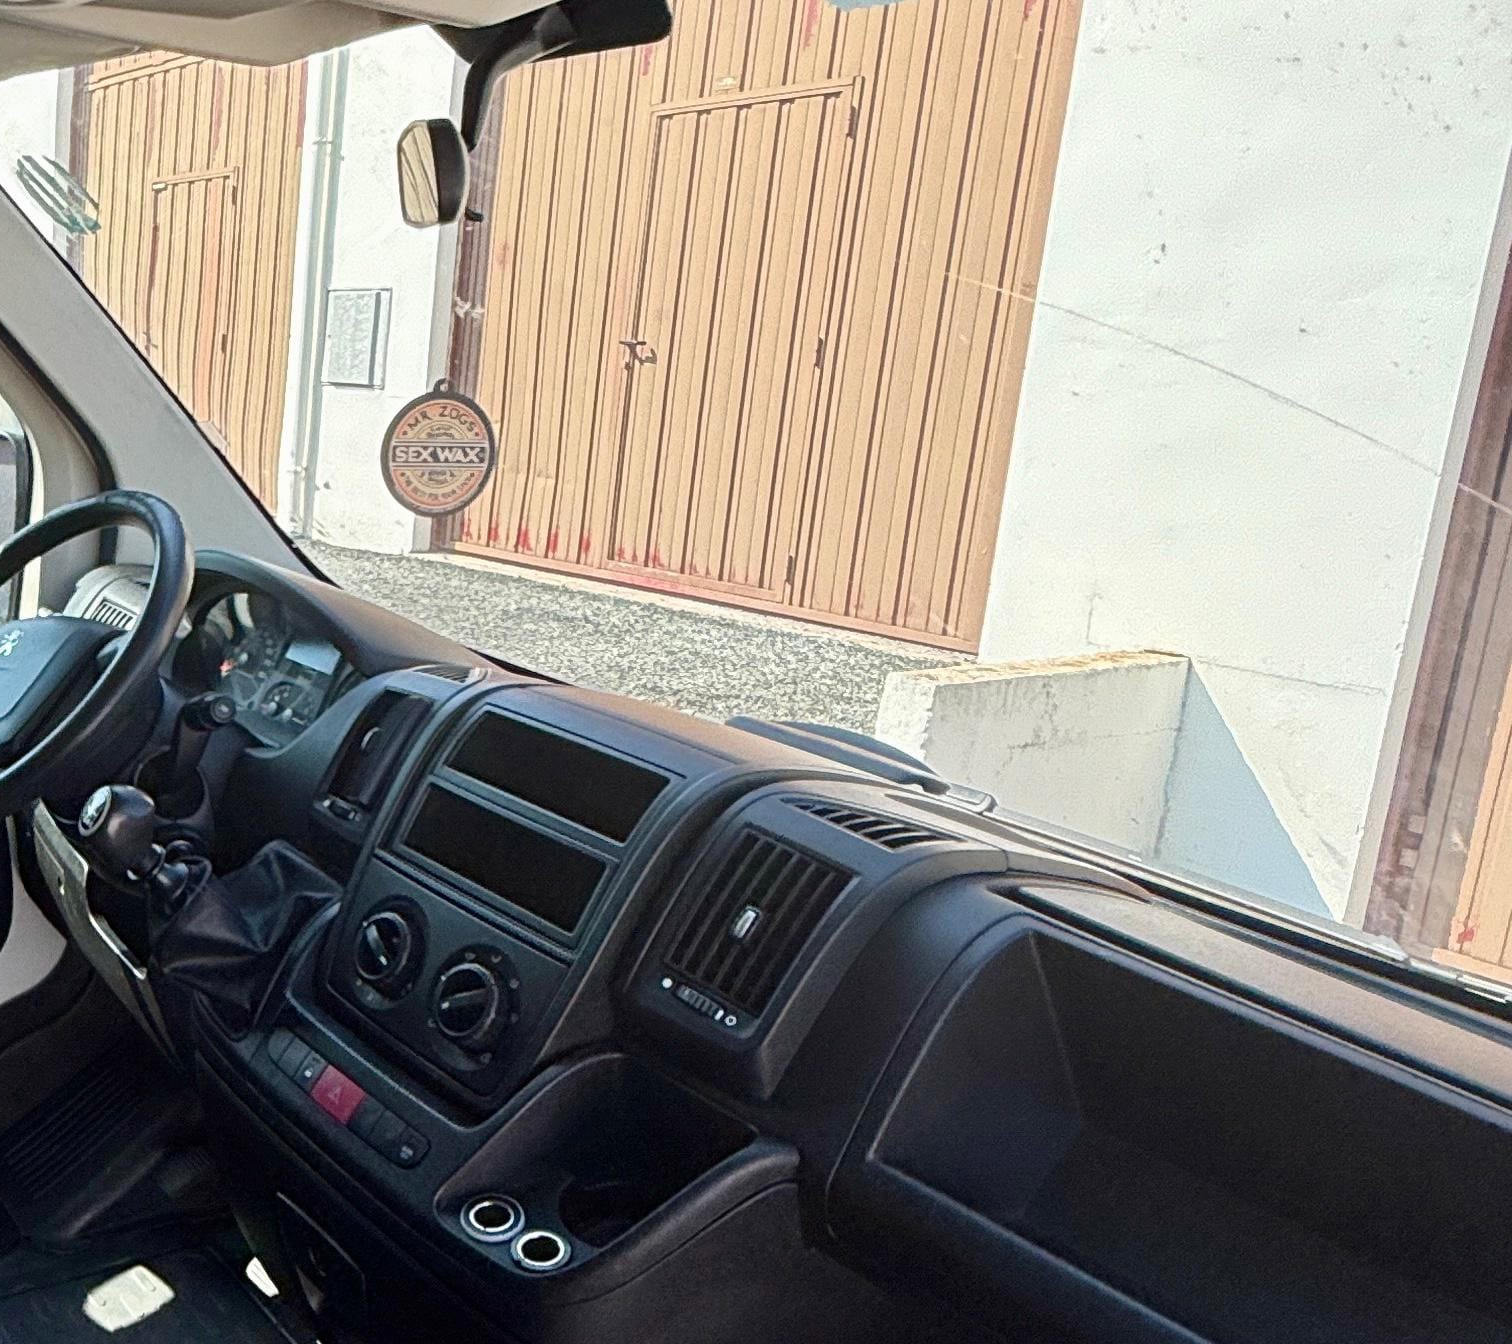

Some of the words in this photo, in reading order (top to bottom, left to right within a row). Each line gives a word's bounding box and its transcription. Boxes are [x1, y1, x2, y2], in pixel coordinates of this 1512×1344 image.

[438, 406, 477, 432] ZOGS
[395, 446, 434, 462] SEX
[436, 447, 480, 463] WAX
